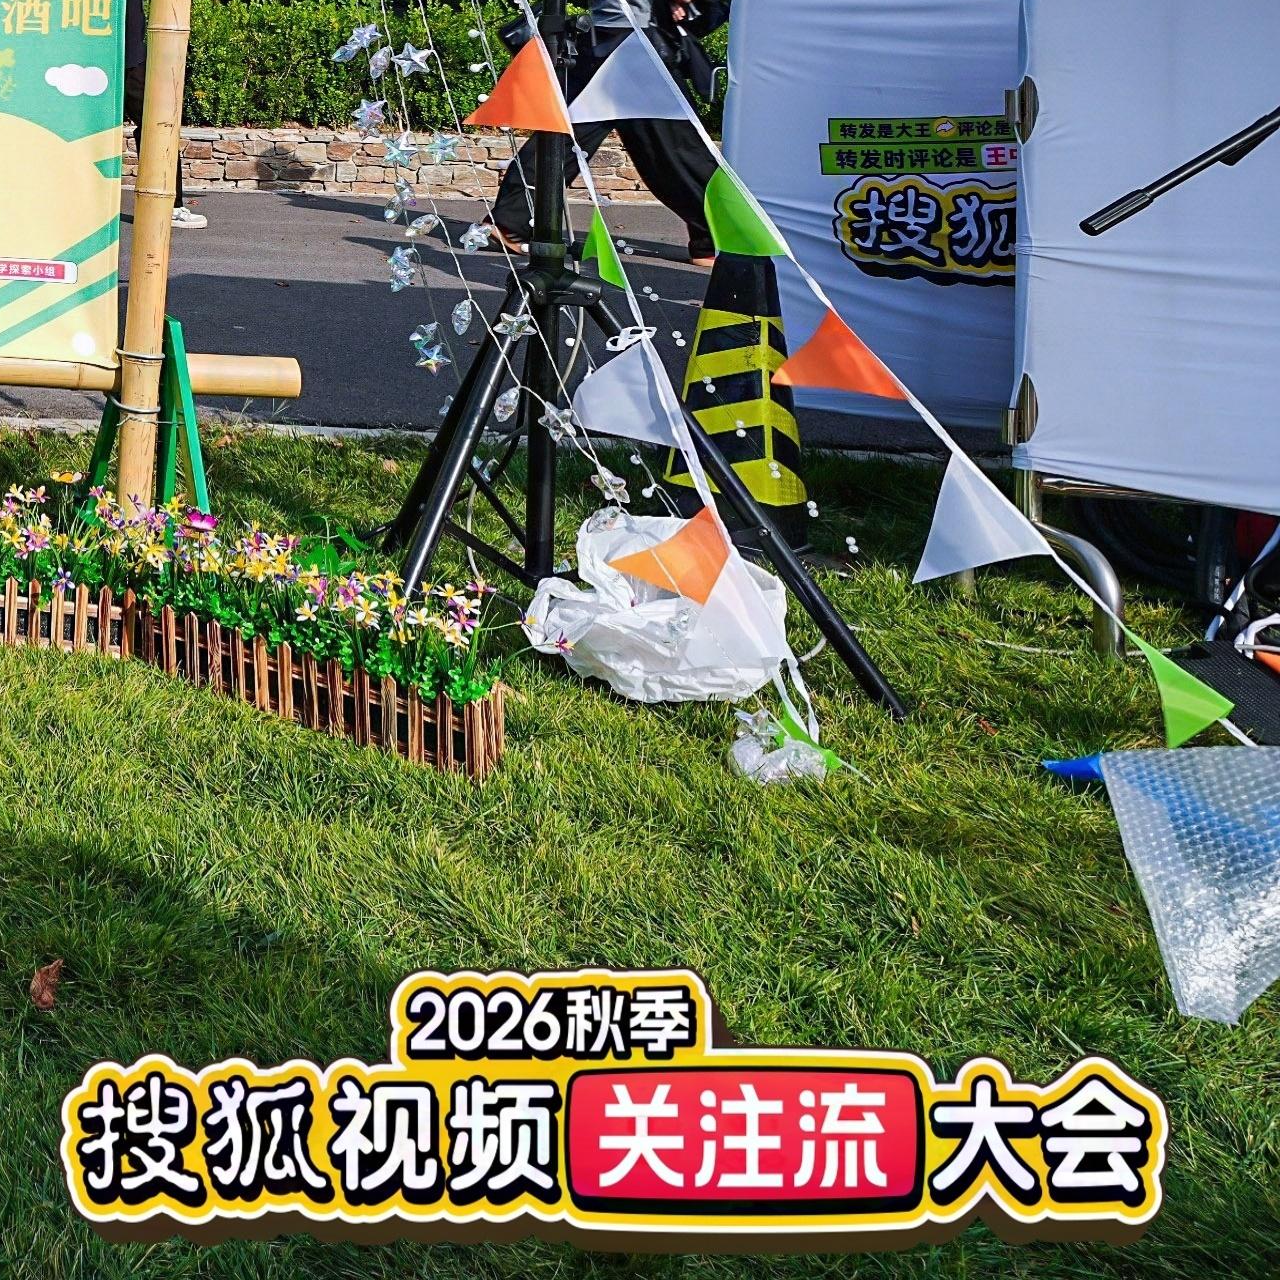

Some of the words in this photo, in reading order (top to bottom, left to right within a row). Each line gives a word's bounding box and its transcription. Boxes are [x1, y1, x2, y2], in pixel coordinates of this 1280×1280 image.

[840, 122, 931, 139] 转发是大王
